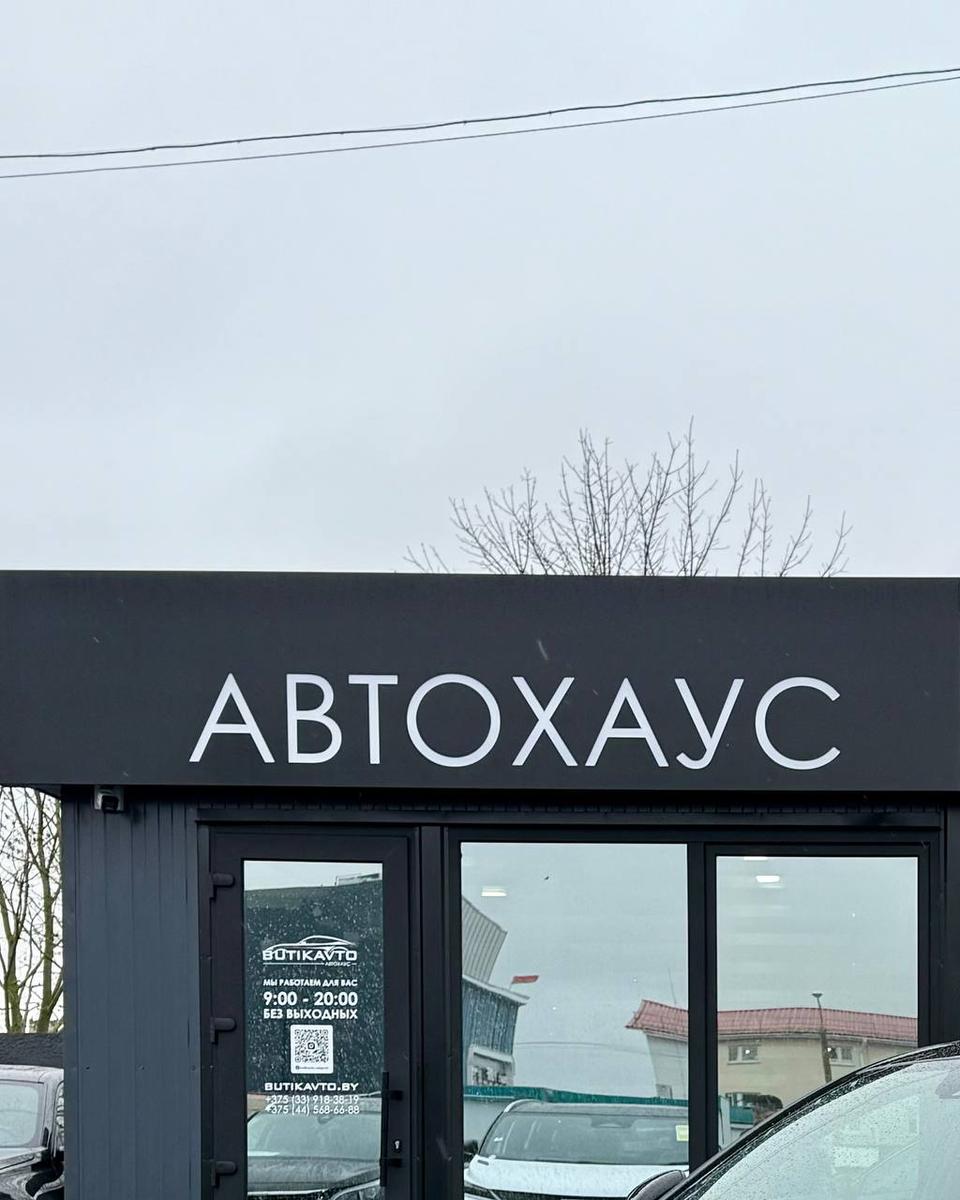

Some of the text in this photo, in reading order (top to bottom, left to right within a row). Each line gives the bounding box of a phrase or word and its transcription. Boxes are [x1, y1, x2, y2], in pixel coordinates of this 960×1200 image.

[189, 673, 841, 770] АВТОХАУС
[262, 950, 357, 961] BUTIKAVTO
[263, 992, 297, 1005] 9:00
[314, 992, 358, 1006] 20:00
[263, 1009, 358, 1020] БЕЗ ВЫХОДНЫХ
[313, 1105, 359, 1114] 568-66-88
